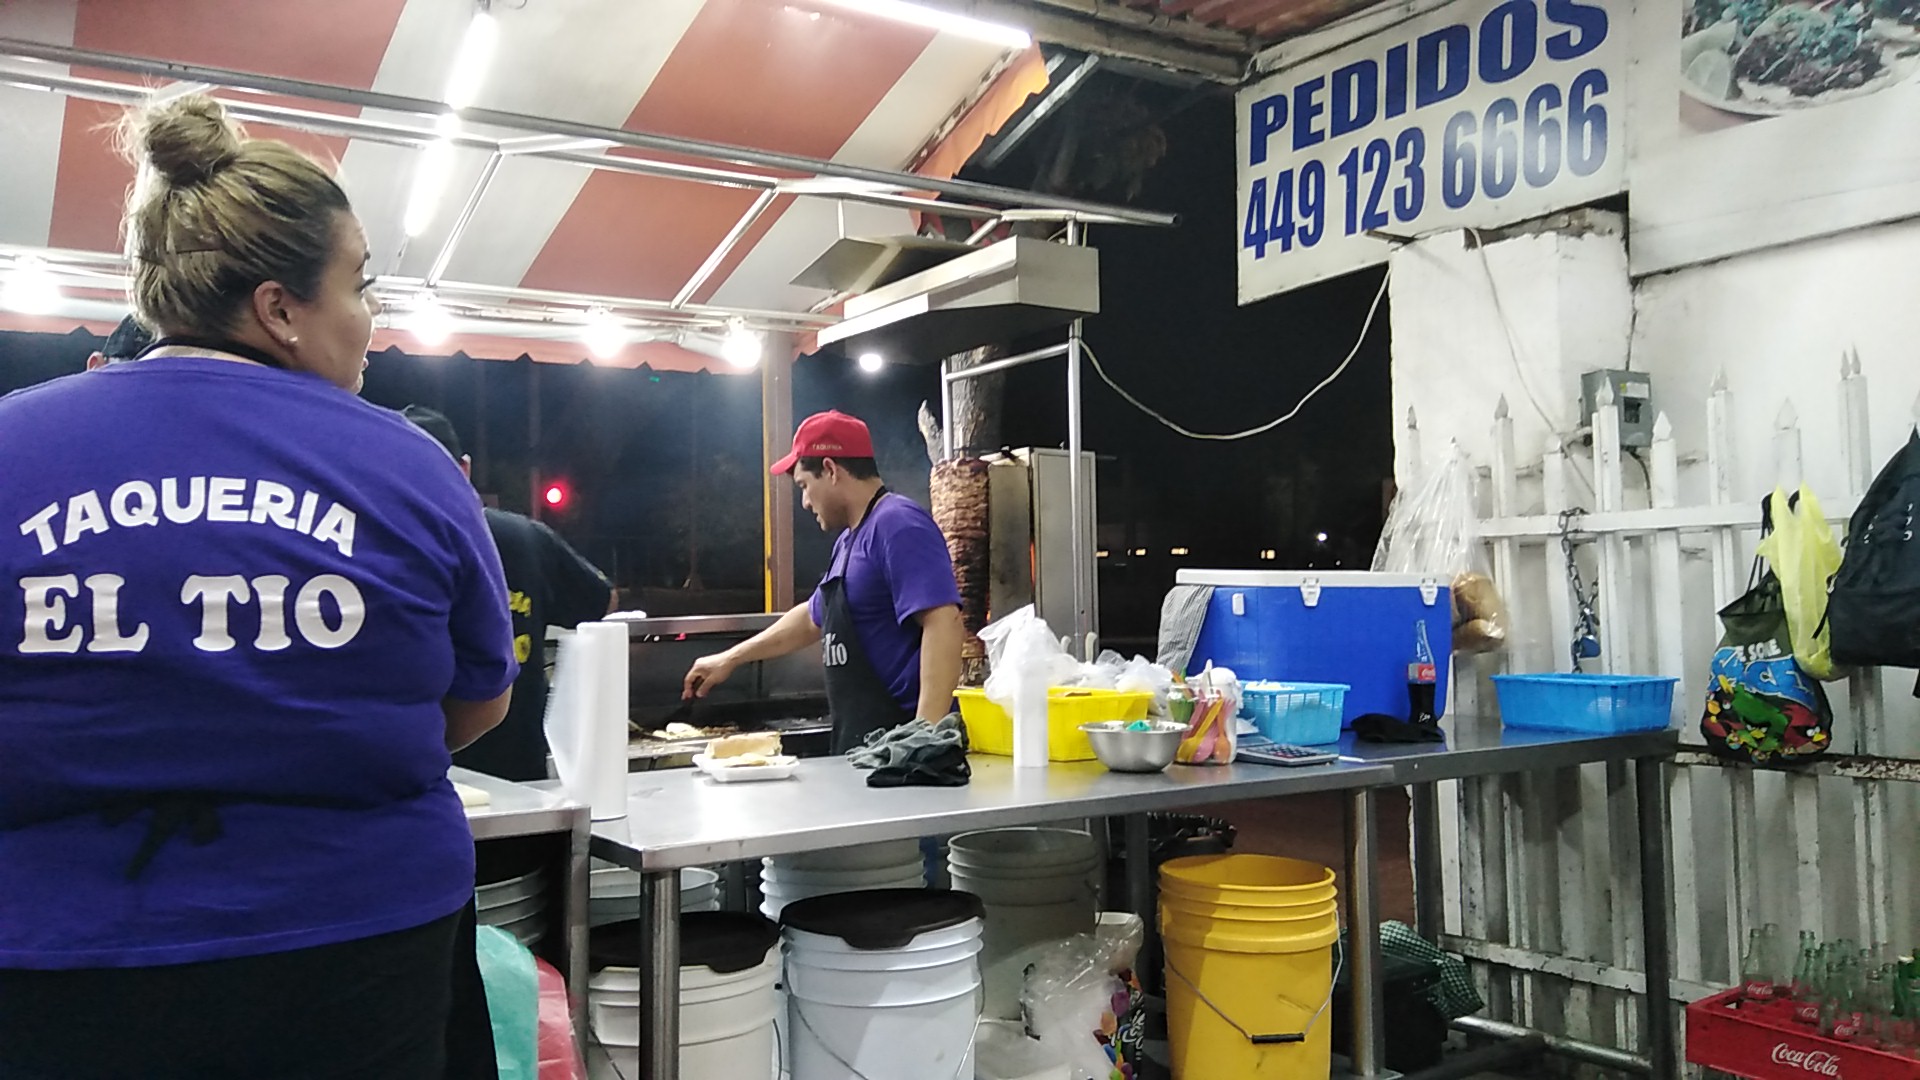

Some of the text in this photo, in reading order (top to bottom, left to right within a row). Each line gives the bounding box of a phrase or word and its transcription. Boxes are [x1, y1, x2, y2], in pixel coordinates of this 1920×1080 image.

[1249, 0, 1609, 167] PEDIDOS
[1243, 68, 1609, 261] 449 123 6666
[20, 476, 357, 557] TAQUERIA
[17, 573, 366, 654] EL TIO
